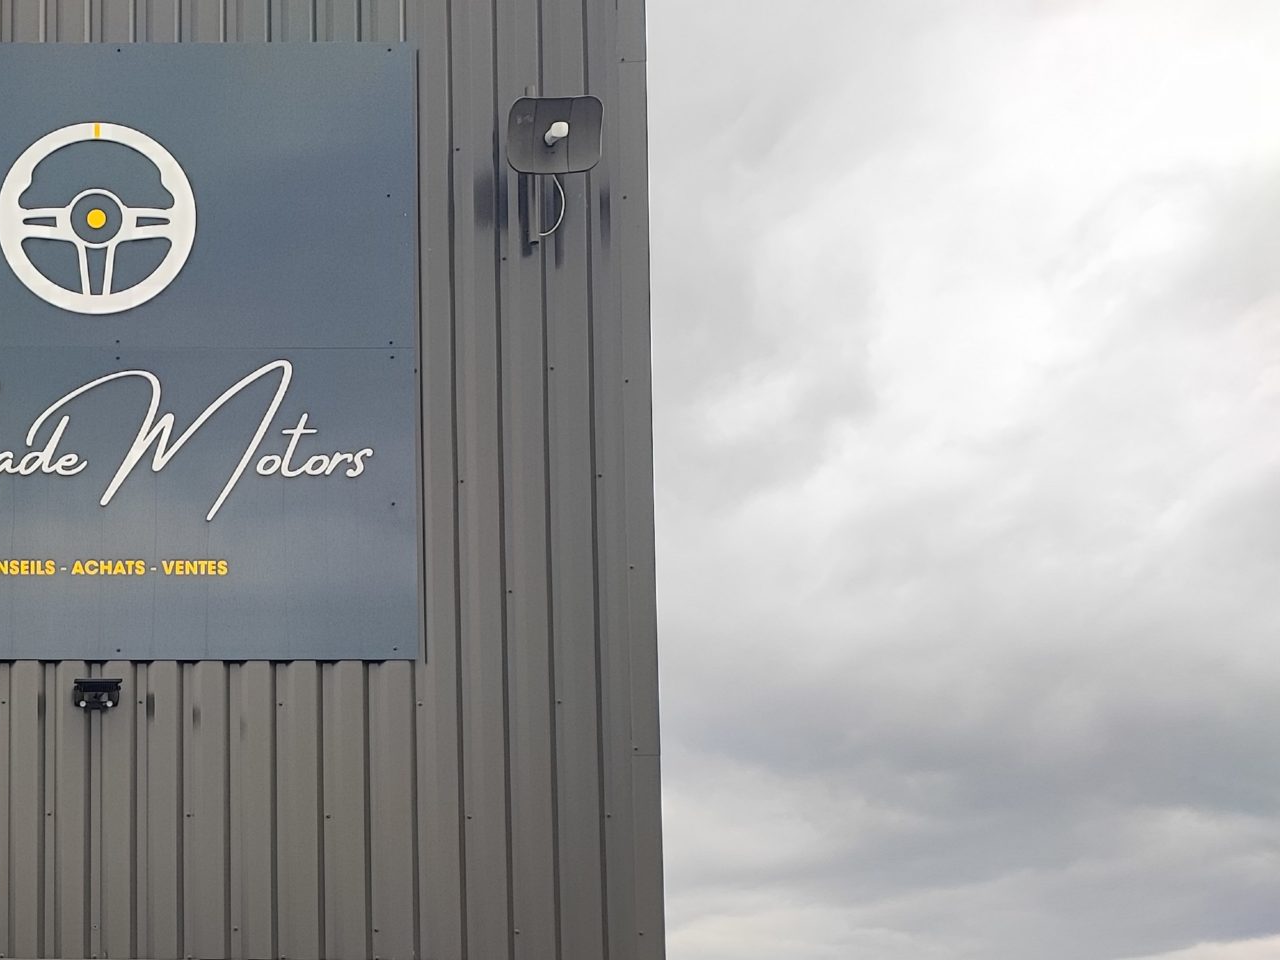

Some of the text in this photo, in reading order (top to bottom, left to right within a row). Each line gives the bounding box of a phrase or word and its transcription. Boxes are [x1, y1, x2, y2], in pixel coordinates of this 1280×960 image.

[25, 359, 374, 521] Motors
[71, 559, 145, 576] ACHATS
[161, 559, 228, 576] VENTES
